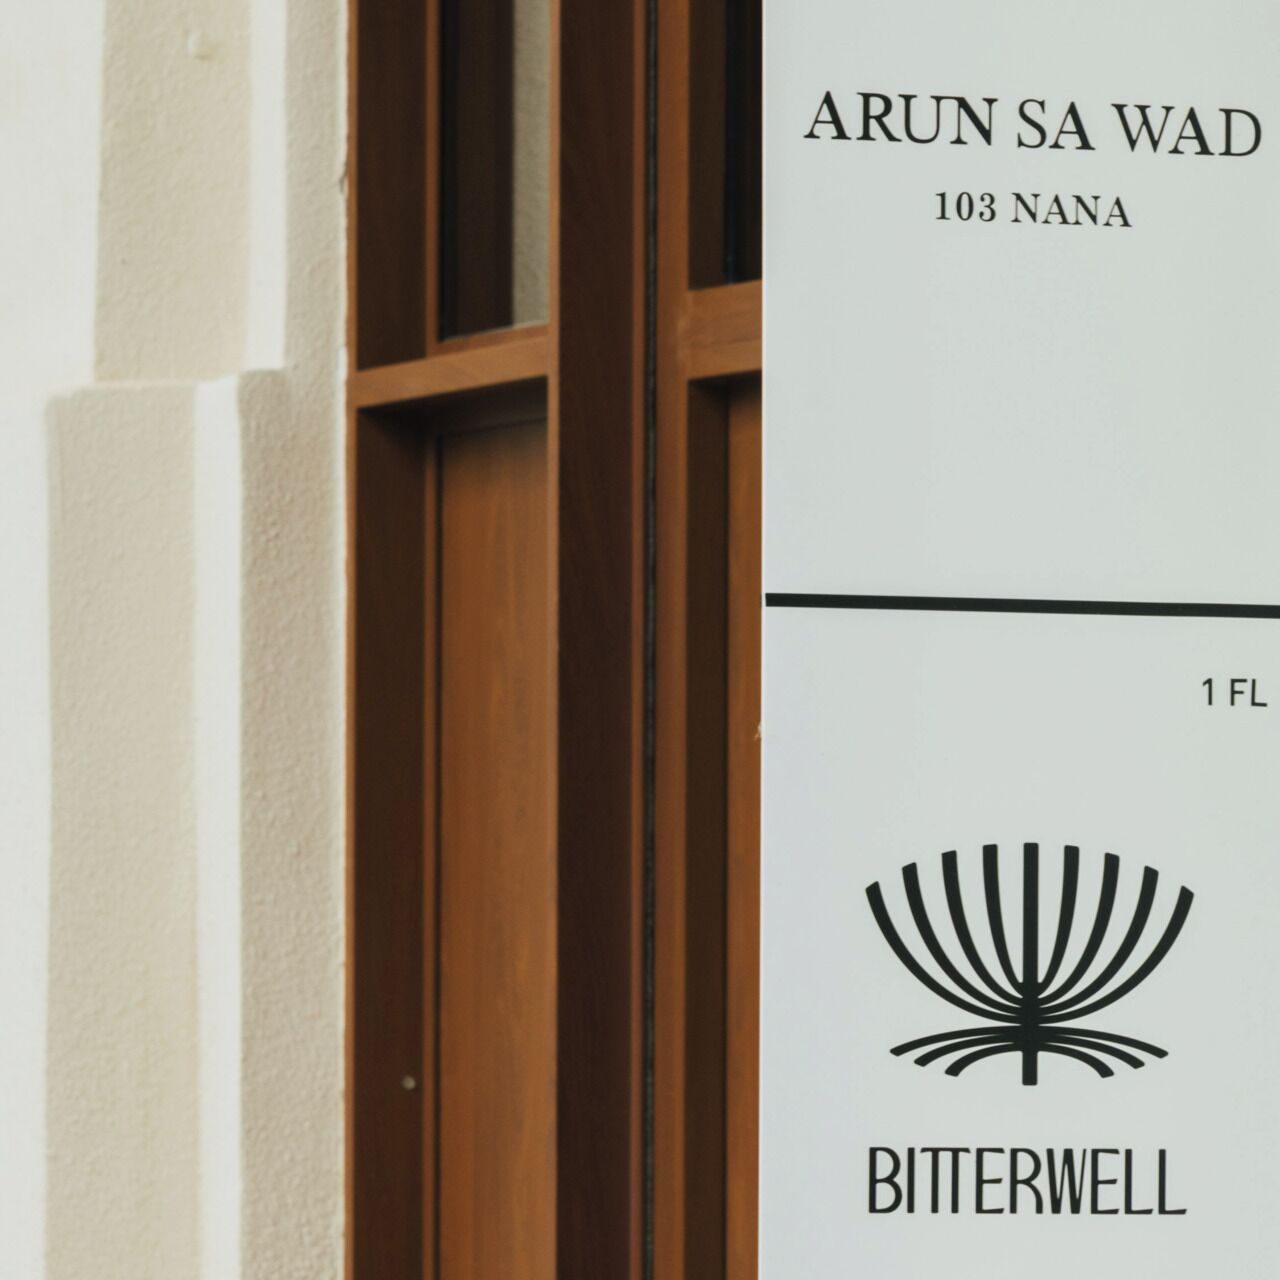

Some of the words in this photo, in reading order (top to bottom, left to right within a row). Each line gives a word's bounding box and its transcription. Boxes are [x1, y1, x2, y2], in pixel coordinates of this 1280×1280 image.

[803, 90, 999, 147] ARUN
[1017, 98, 1096, 151] SA
[1110, 103, 1262, 157] WAD
[935, 191, 997, 223] 103
[1010, 192, 1133, 228] NANA
[1202, 677, 1213, 706] 1
[1230, 678, 1268, 708] FL
[867, 1146, 1188, 1216] BITTERWELL
